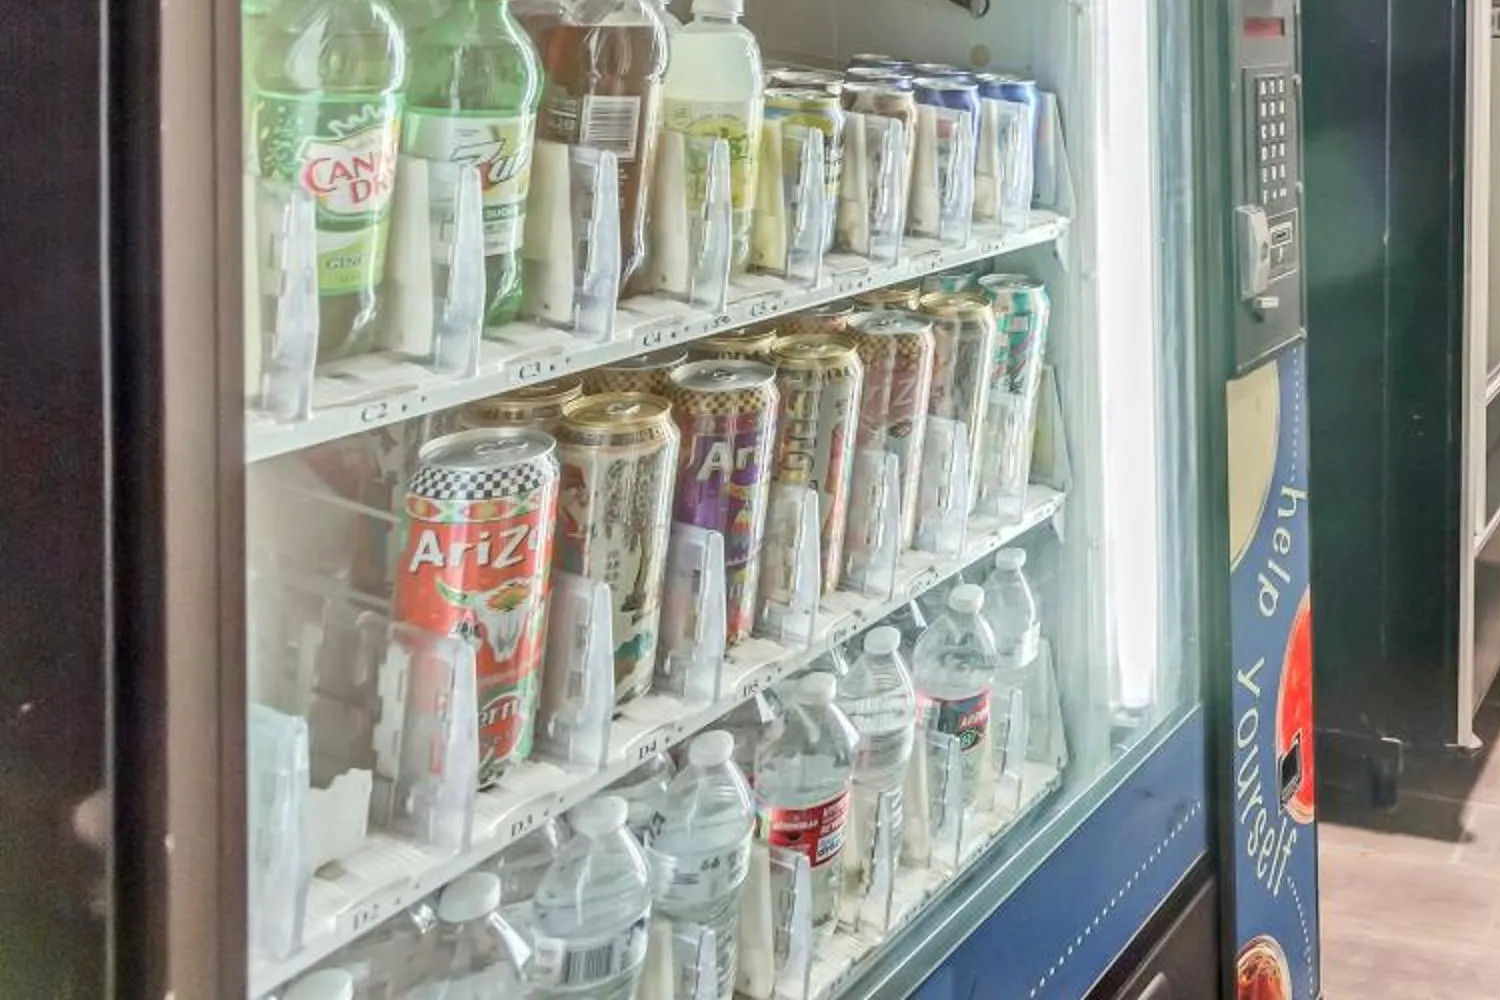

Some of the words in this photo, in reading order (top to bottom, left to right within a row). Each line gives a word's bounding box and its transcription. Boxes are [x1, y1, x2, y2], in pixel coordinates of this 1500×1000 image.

[518, 361, 541, 380] C3
[360, 402, 388, 423] C2
[1257, 485, 1309, 618] help
[638, 738, 658, 760] D4
[1236, 656, 1298, 897] yourself
